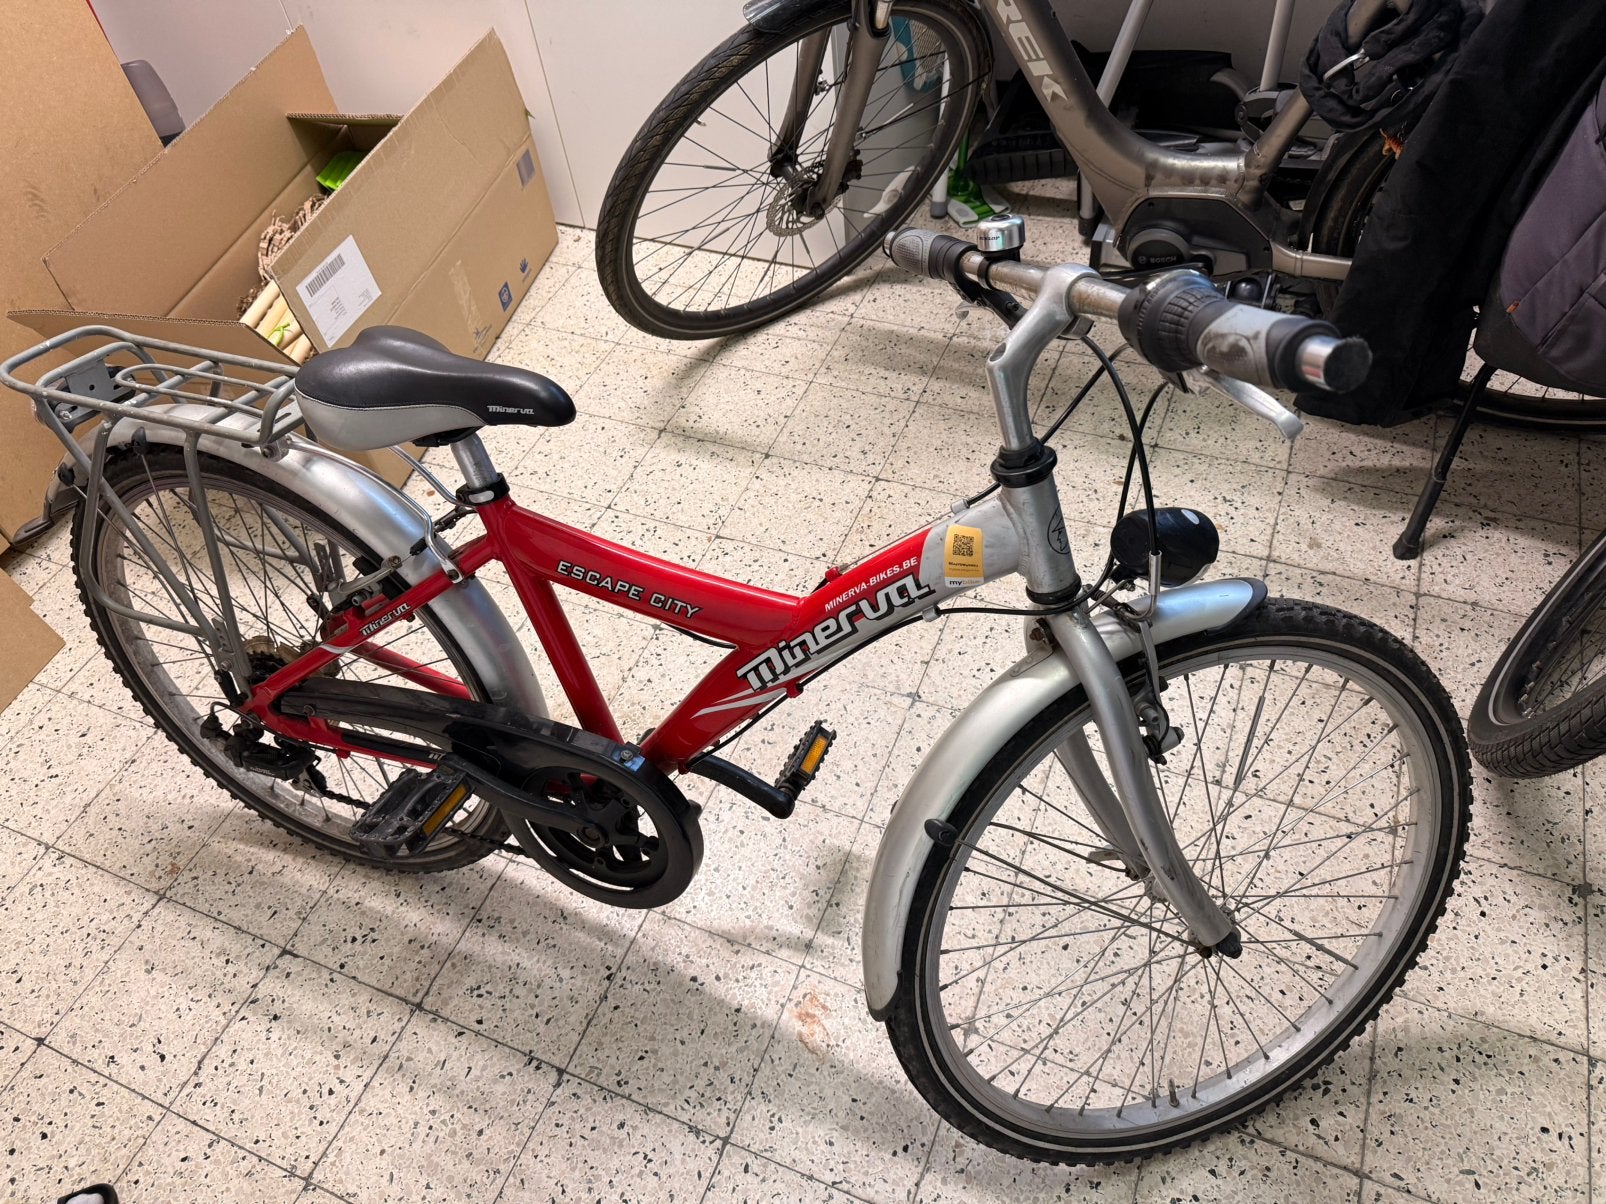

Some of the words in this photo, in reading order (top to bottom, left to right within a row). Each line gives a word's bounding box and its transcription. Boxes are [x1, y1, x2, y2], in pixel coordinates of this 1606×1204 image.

[557, 560, 643, 600] ESCAPE
[650, 593, 700, 618] CITY
[824, 556, 919, 612] MINERVA-BIKES.BE
